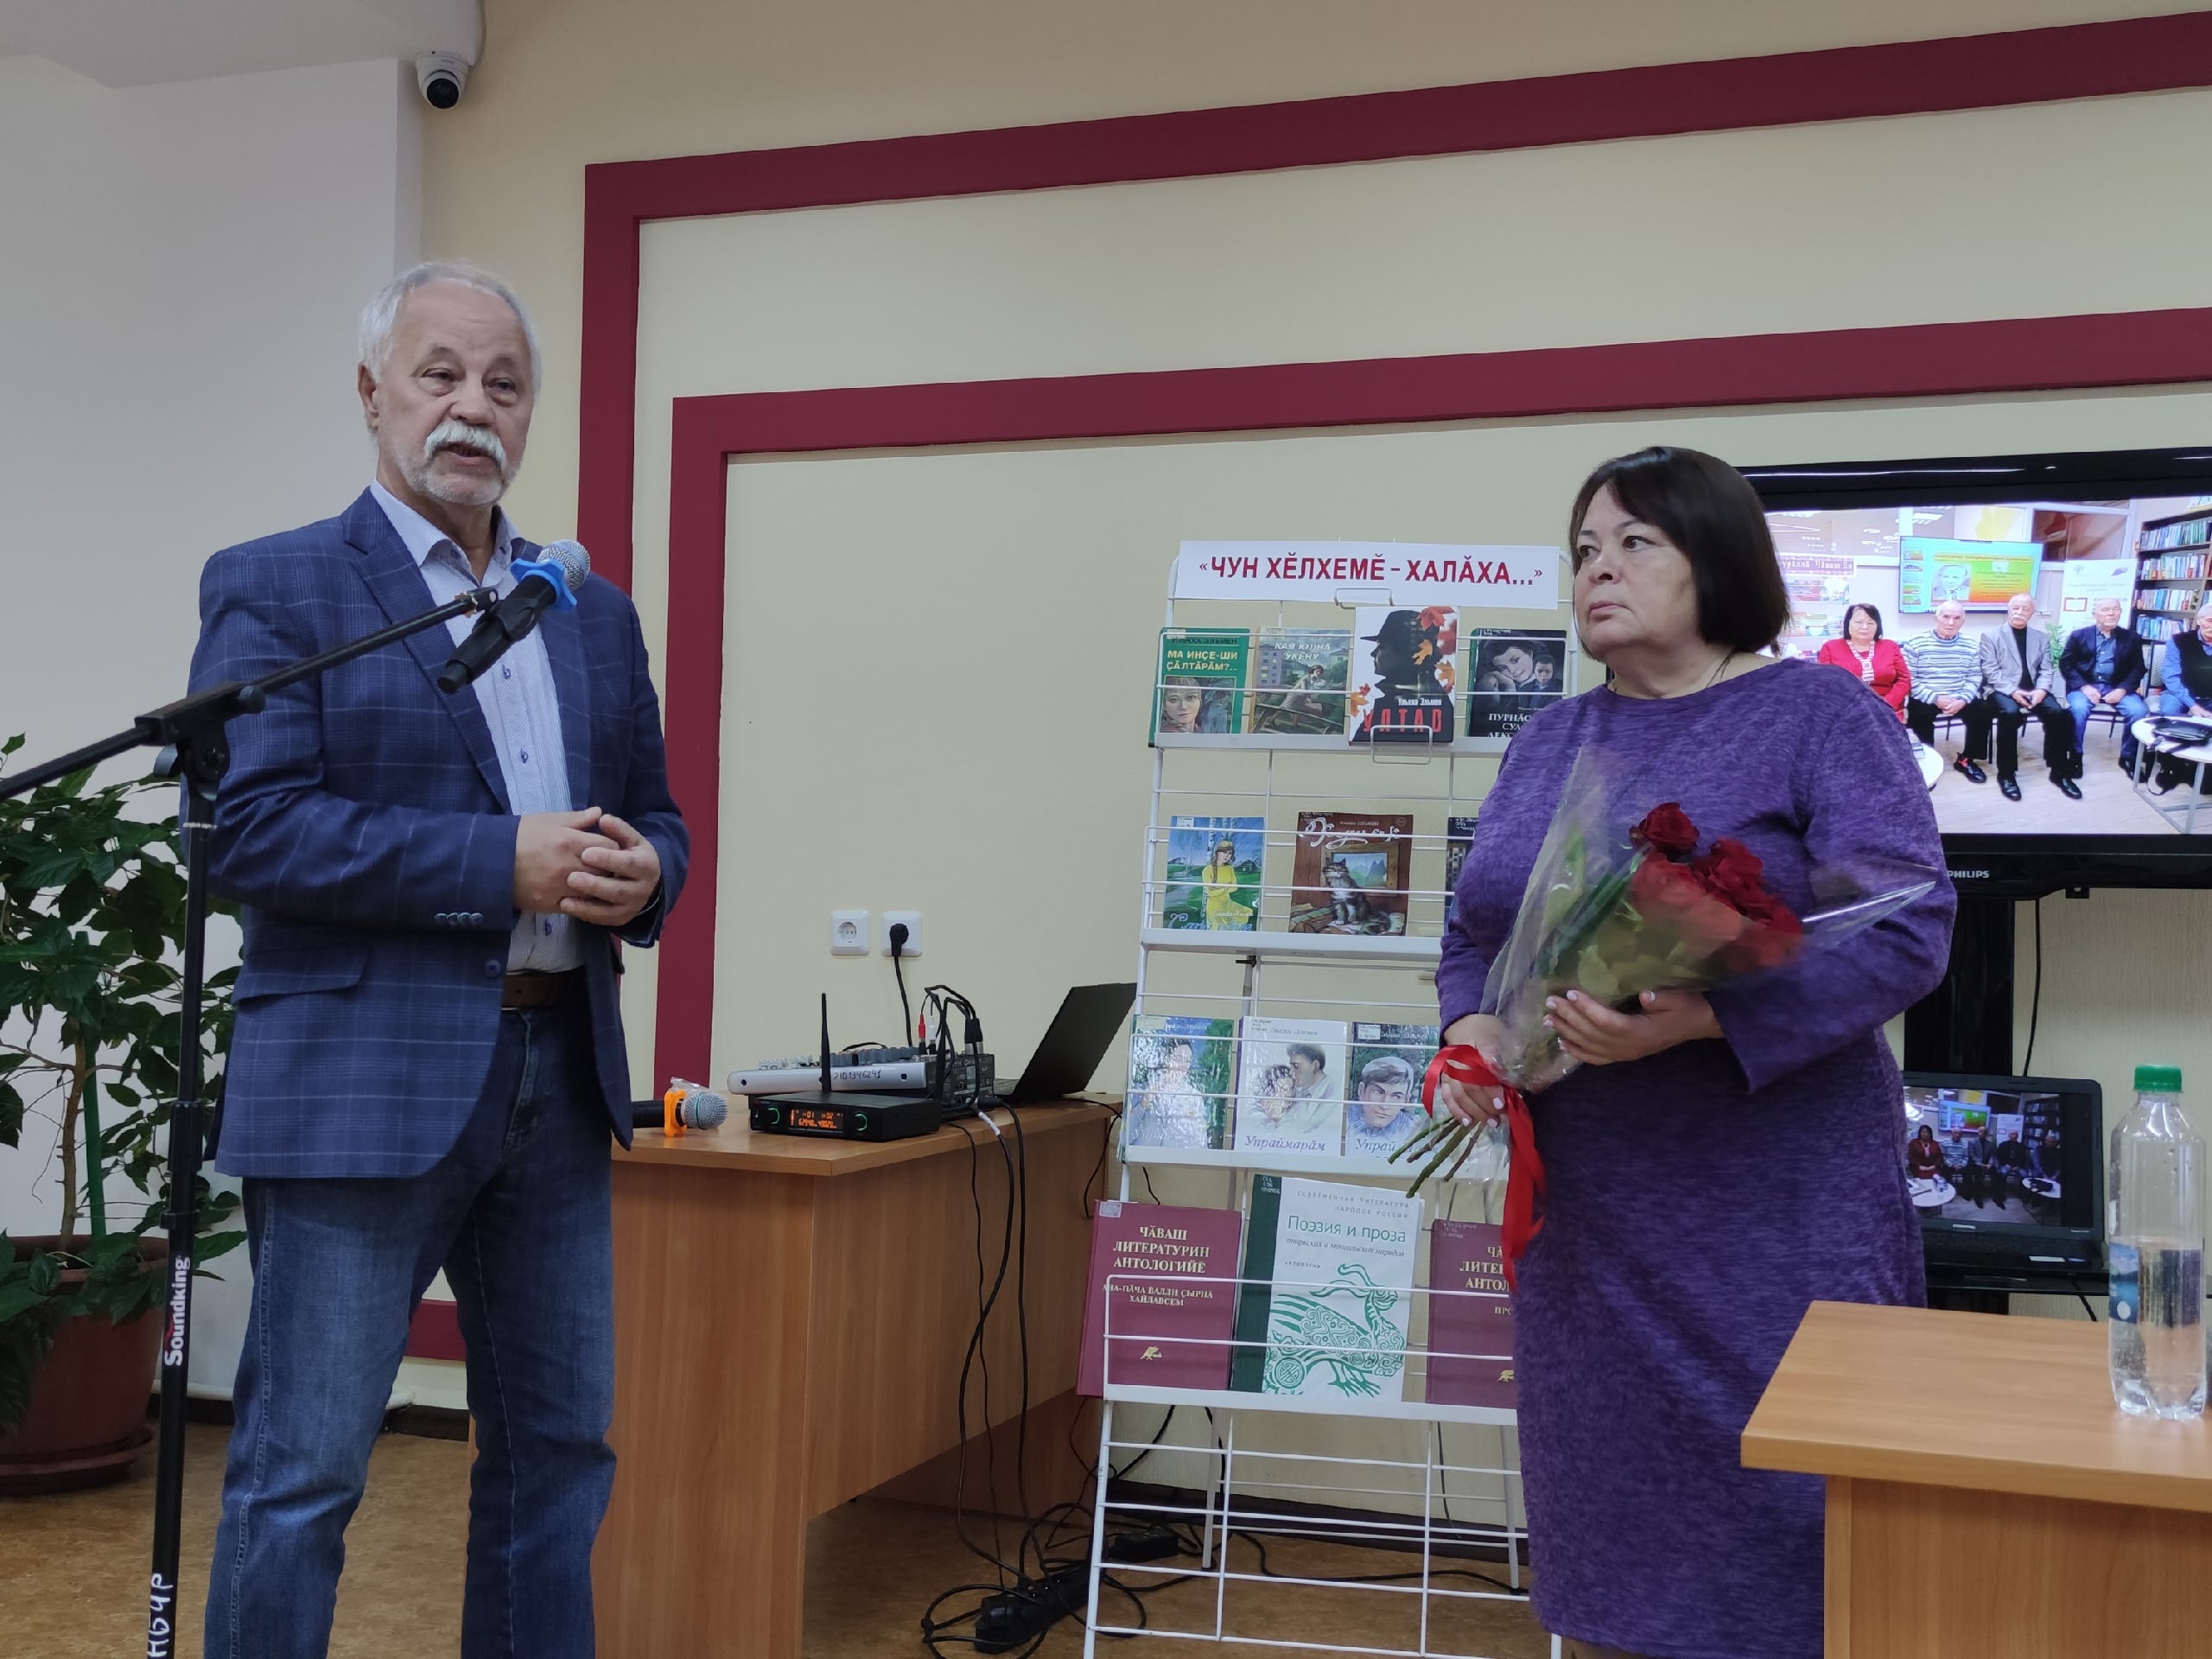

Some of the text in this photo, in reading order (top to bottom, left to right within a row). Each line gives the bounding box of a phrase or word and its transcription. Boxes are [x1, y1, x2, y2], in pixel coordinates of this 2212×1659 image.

[1167, 650, 1184, 658] МА
[1948, 870, 1990, 879] PHILIPS
[1288, 1215, 1406, 1243] Поэзия и проза
[1113, 1241, 1210, 1257] ЛИТЕРАТУРИН
[1465, 1277, 1510, 1292] АНТОЛ
[164, 1255, 190, 1366] Soundking
[1494, 1306, 1512, 1315] ПРО
